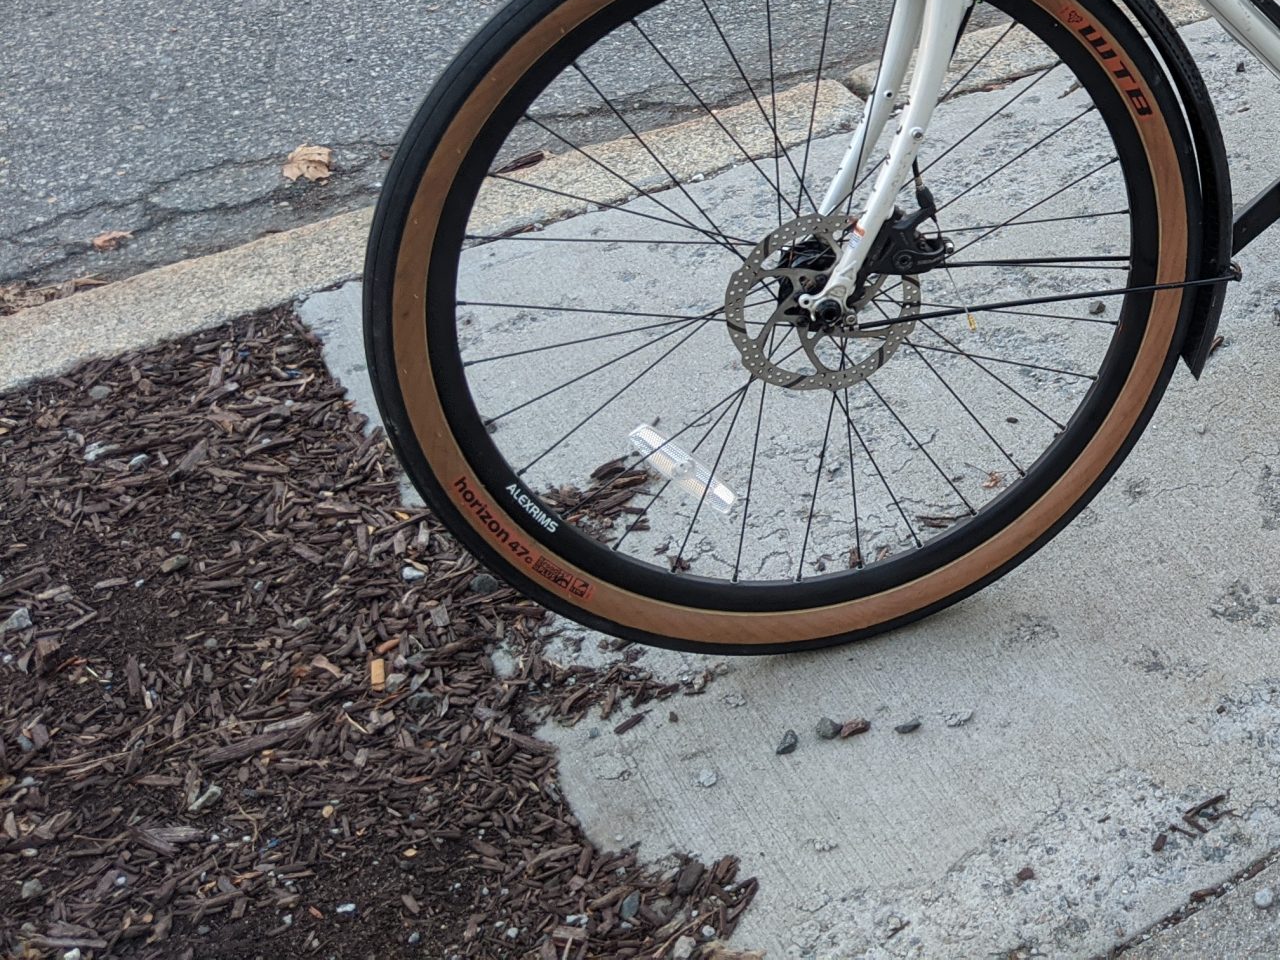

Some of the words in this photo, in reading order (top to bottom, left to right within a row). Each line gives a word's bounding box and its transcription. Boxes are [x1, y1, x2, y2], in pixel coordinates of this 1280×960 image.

[1078, 24, 1153, 116] WTB
[454, 476, 511, 544] horizon
[505, 483, 560, 534] ALEXRIMS
